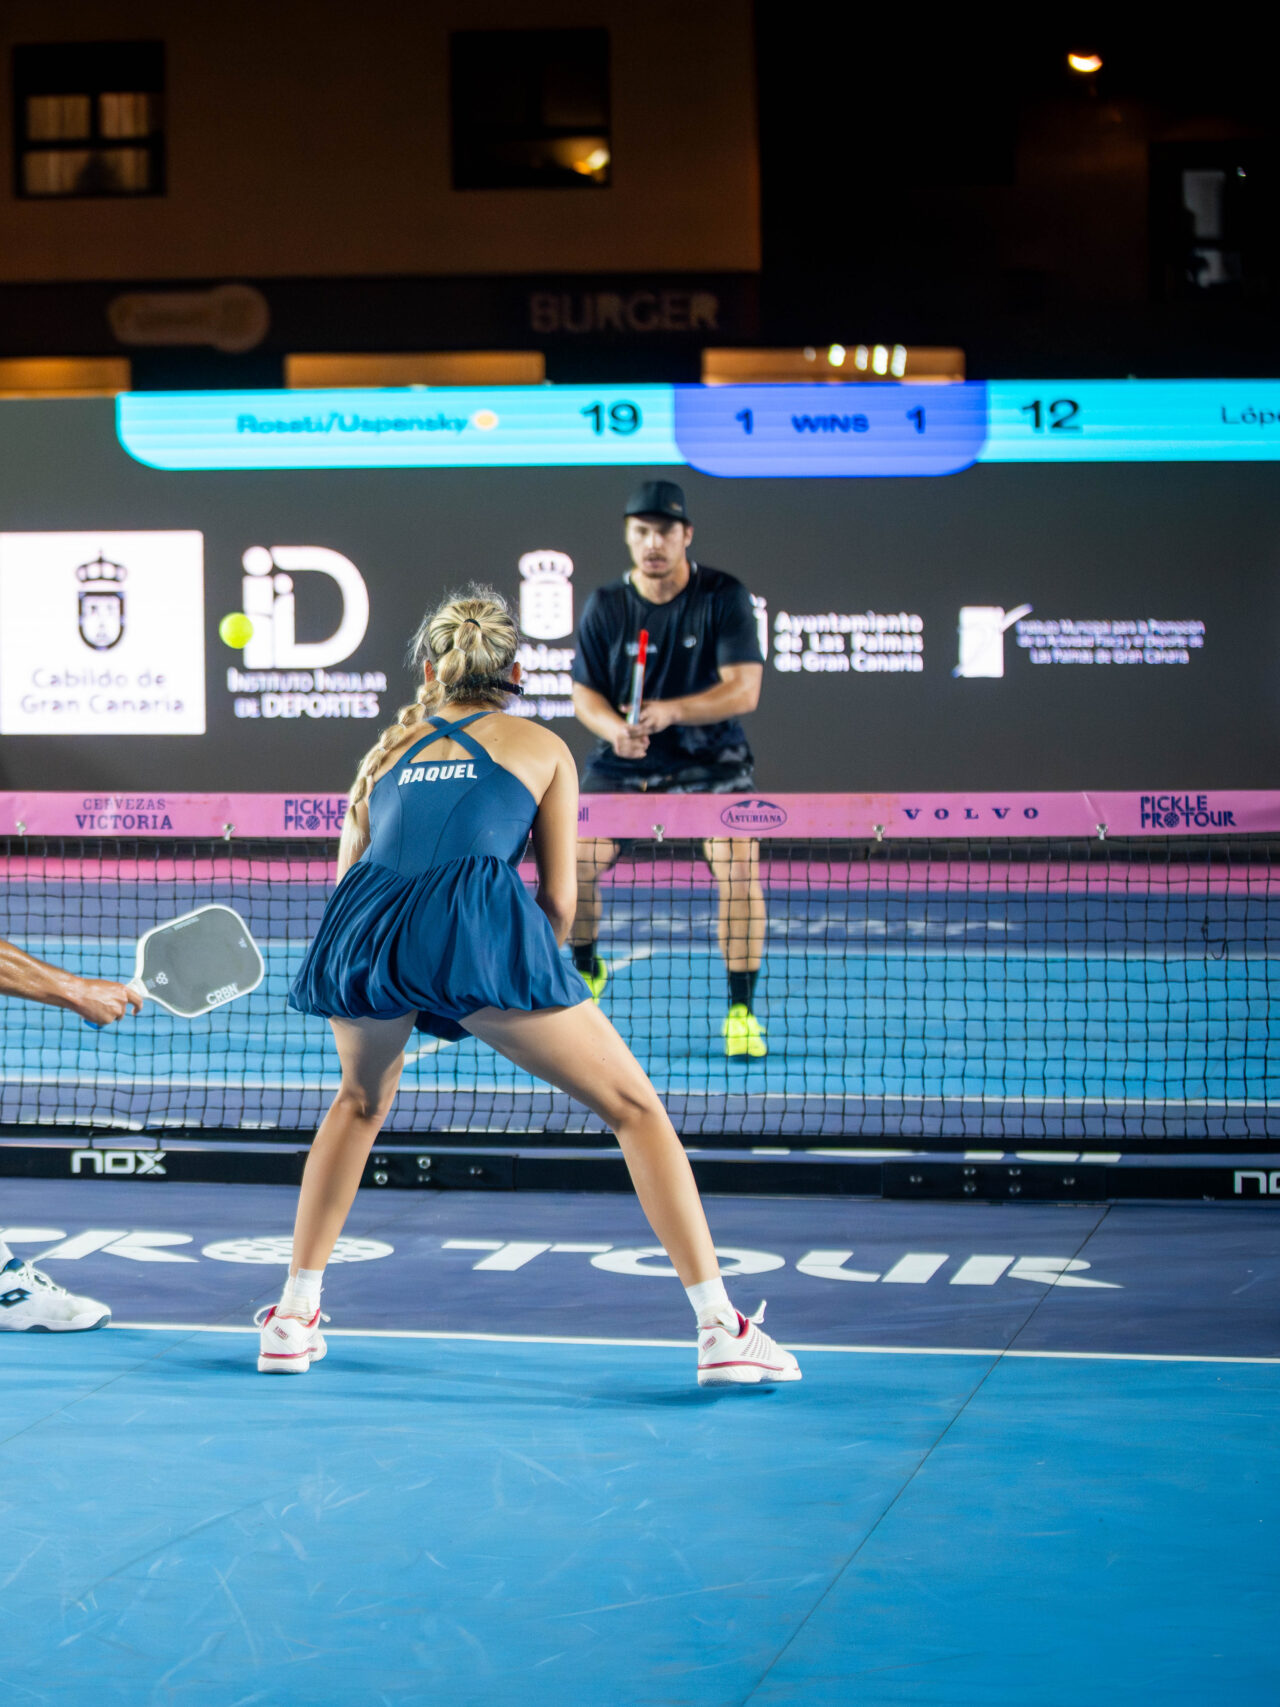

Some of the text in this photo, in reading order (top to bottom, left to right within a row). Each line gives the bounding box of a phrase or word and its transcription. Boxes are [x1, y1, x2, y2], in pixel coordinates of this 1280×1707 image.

[530, 292, 719, 331] BURGER
[581, 400, 644, 436] 19
[735, 407, 926, 434] 1 WINS 1
[1022, 399, 1081, 432] 12
[1221, 405, 1280, 430] Lóp
[774, 610, 923, 636] Ayuntamiento
[773, 632, 924, 653] de Las Palmas
[773, 650, 924, 672] de Gran Canaria
[31, 668, 167, 690] Cabildo de
[20, 694, 185, 714] Gran Canaria
[261, 692, 380, 718] DEPORTES
[397, 763, 478, 786] RAQUEL
[82, 798, 166, 811] CERVEZAS
[284, 799, 349, 816] PICKLE
[904, 807, 1039, 821] VOLVO
[1140, 795, 1208, 812] PICKLE
[75, 814, 173, 831] VICTORIA
[206, 983, 240, 1006] CRBN
[442, 1239, 1124, 1289] TOUR
